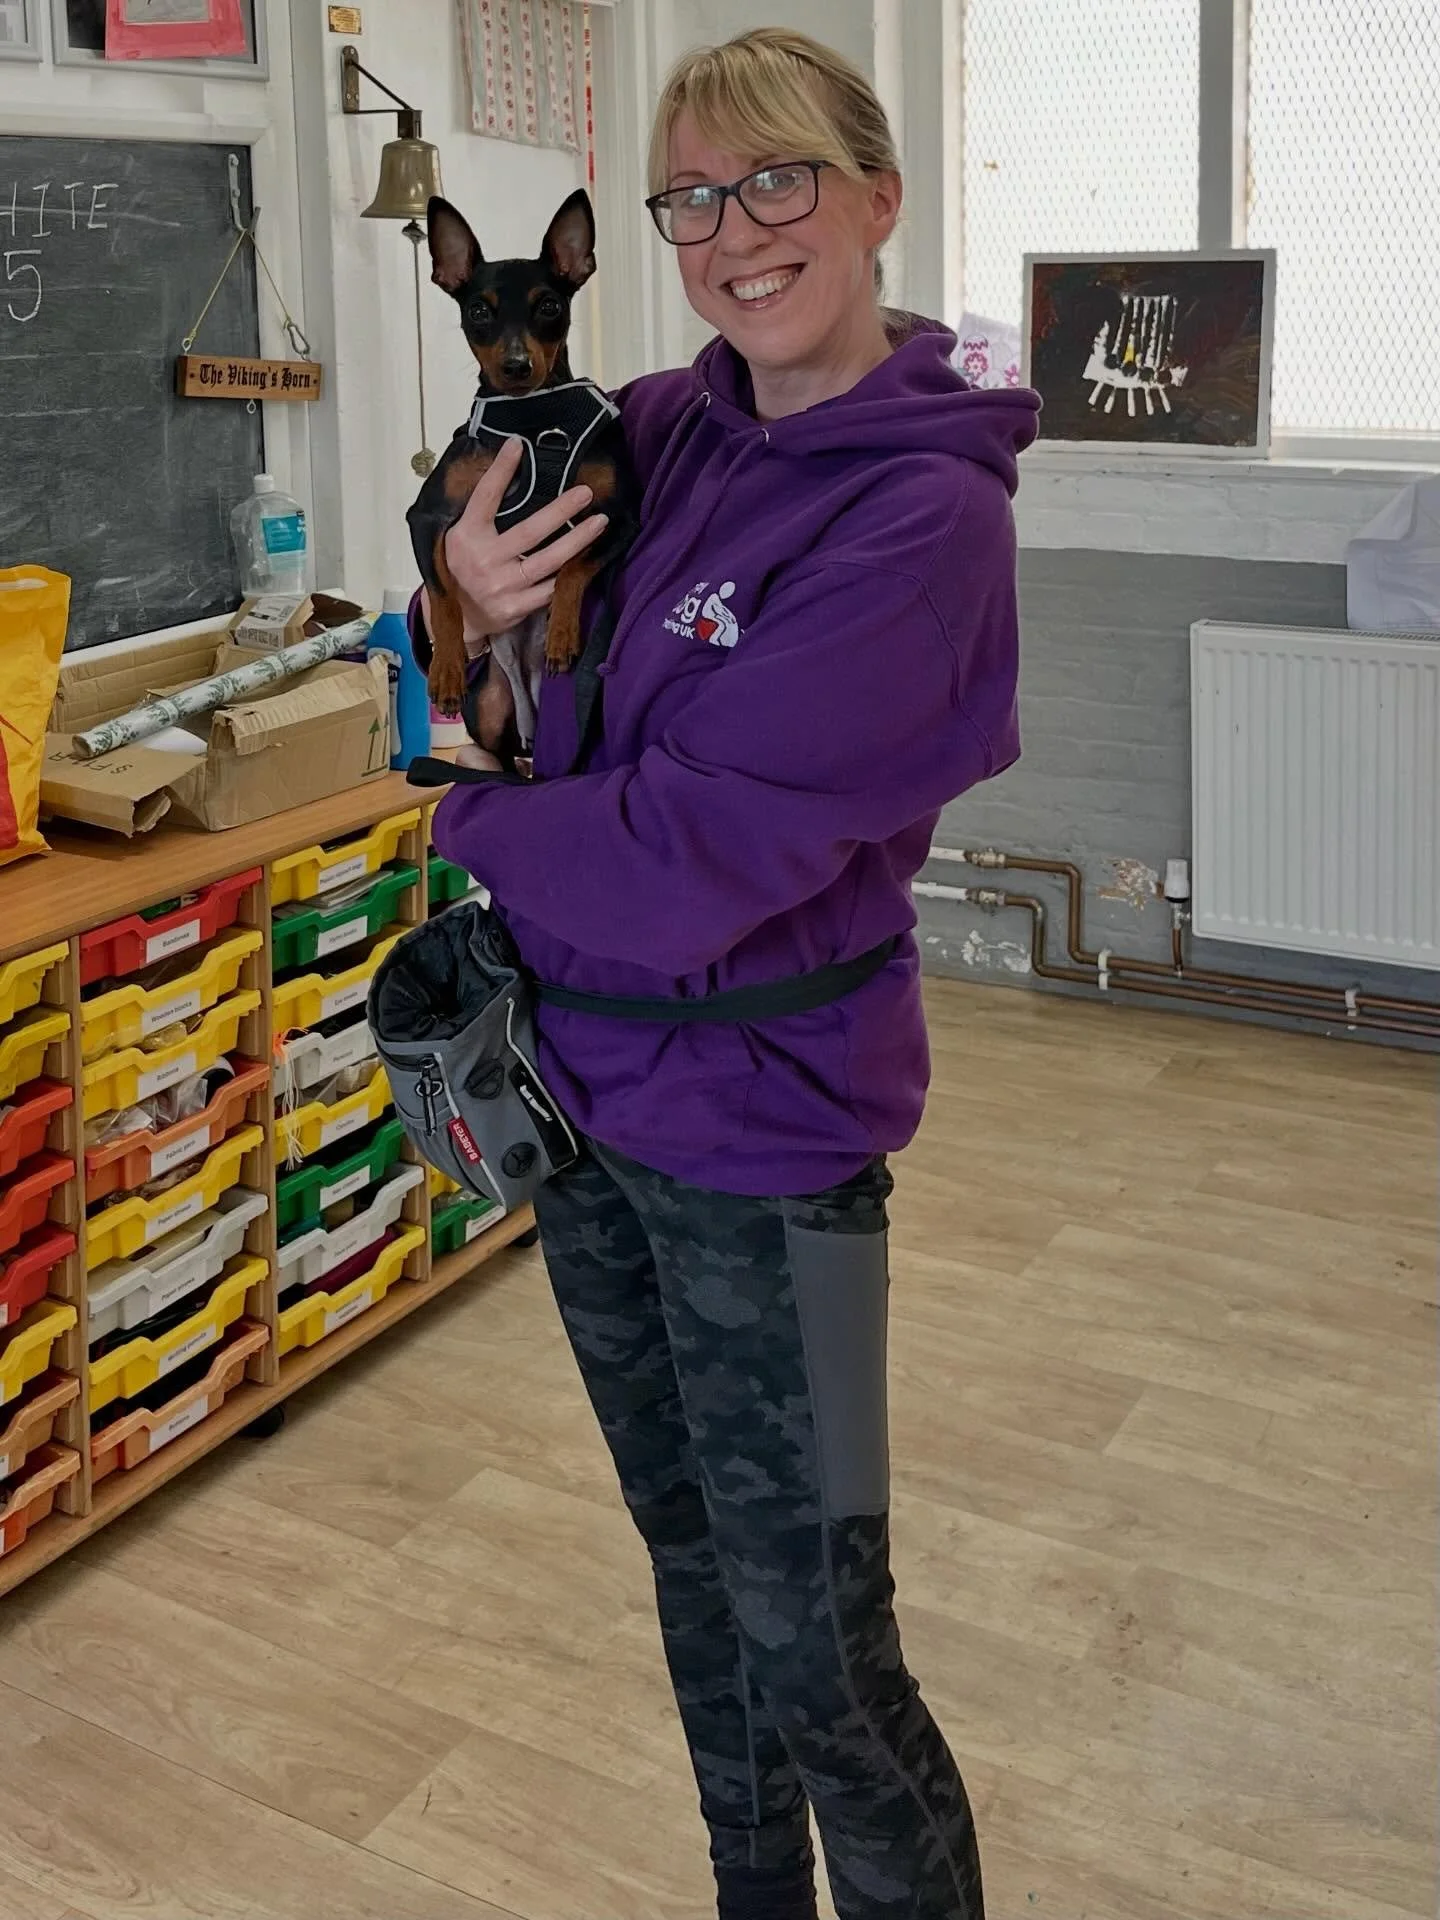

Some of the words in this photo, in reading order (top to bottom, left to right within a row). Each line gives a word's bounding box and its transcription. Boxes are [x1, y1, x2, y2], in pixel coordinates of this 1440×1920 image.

[200, 364, 223, 388] The
[228, 364, 278, 389] Viking's
[281, 367, 310, 391] Horn
